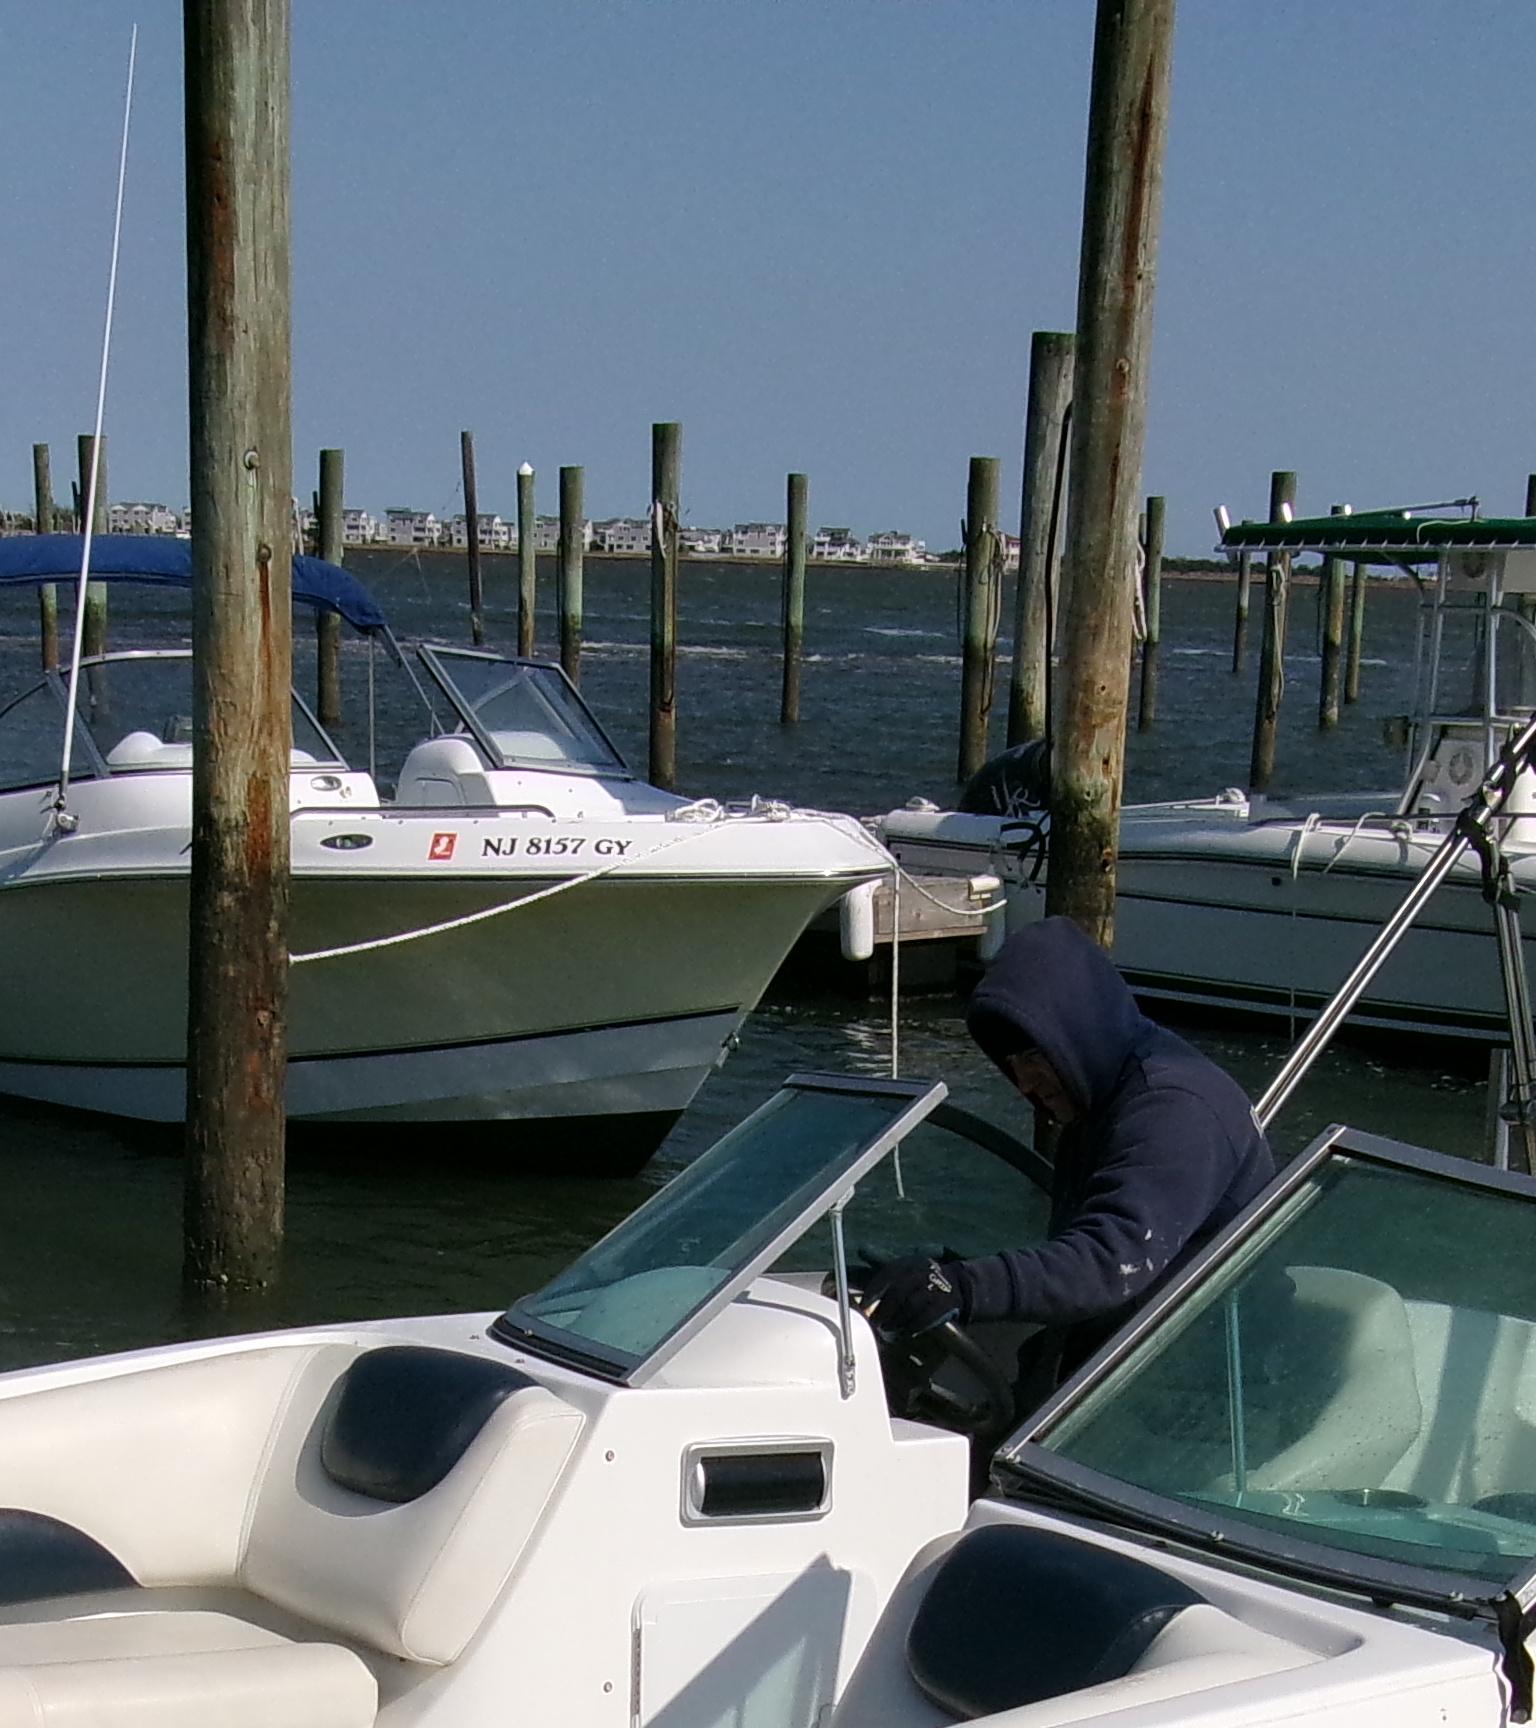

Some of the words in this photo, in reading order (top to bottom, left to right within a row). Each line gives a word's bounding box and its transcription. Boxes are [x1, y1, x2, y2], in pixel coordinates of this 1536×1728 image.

[481, 838, 518, 857] NJ
[525, 837, 586, 856] 8157
[594, 838, 632, 856] GY
